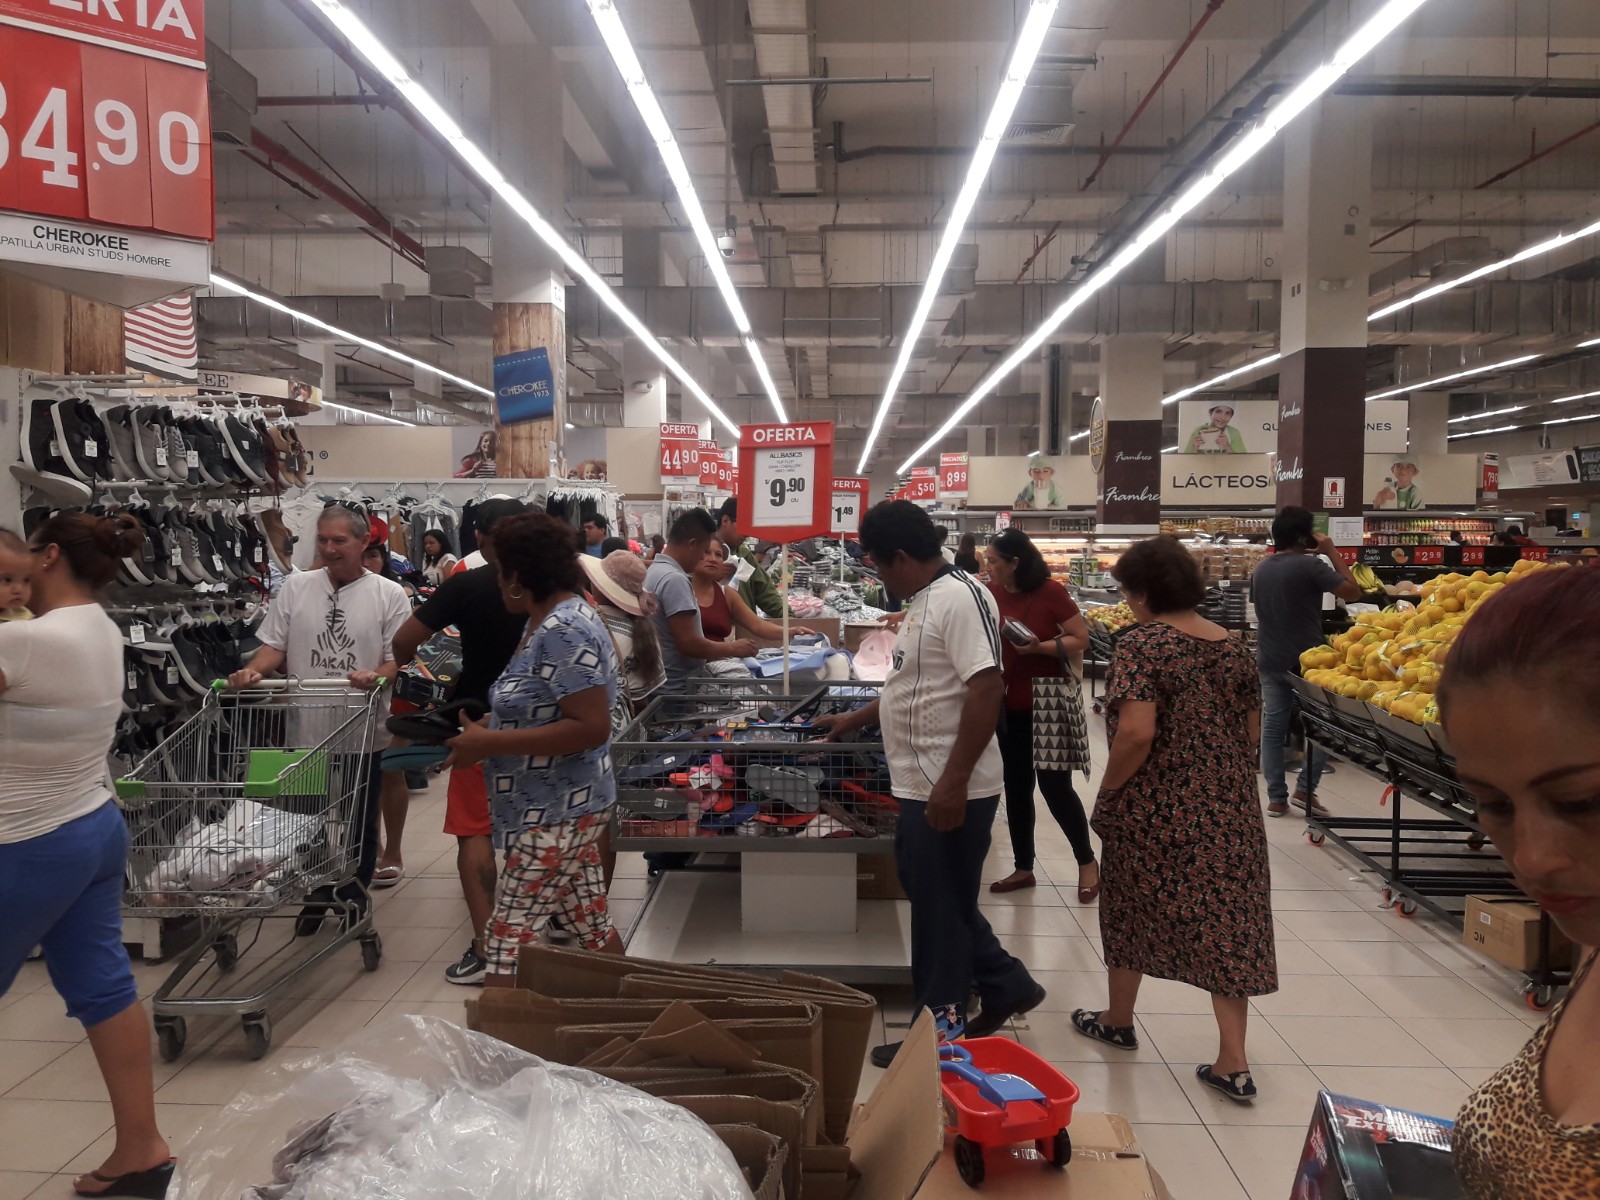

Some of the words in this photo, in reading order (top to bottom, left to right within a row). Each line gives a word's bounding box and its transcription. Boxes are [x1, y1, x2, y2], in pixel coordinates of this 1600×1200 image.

[33, 225, 129, 250] CHEROKEE
[0, 235, 44, 250] PATILLA
[46, 242, 85, 257] URBAN
[88, 247, 124, 261] STUDS
[126, 253, 172, 267] HOMBRE
[198, 372, 229, 388] EE
[499, 380, 548, 397] CHEROKEE
[533, 389, 549, 398] 1973
[661, 424, 697, 435] OFERTA
[1364, 422, 1392, 431] NES
[752, 427, 816, 443] OFERTA
[1114, 451, 1152, 463] Fiambres
[832, 480, 861, 488] FERTA
[1172, 472, 1268, 489] LÁCTEOS
[770, 478, 806, 507] 9.90
[311, 649, 357, 671] DAKAR
